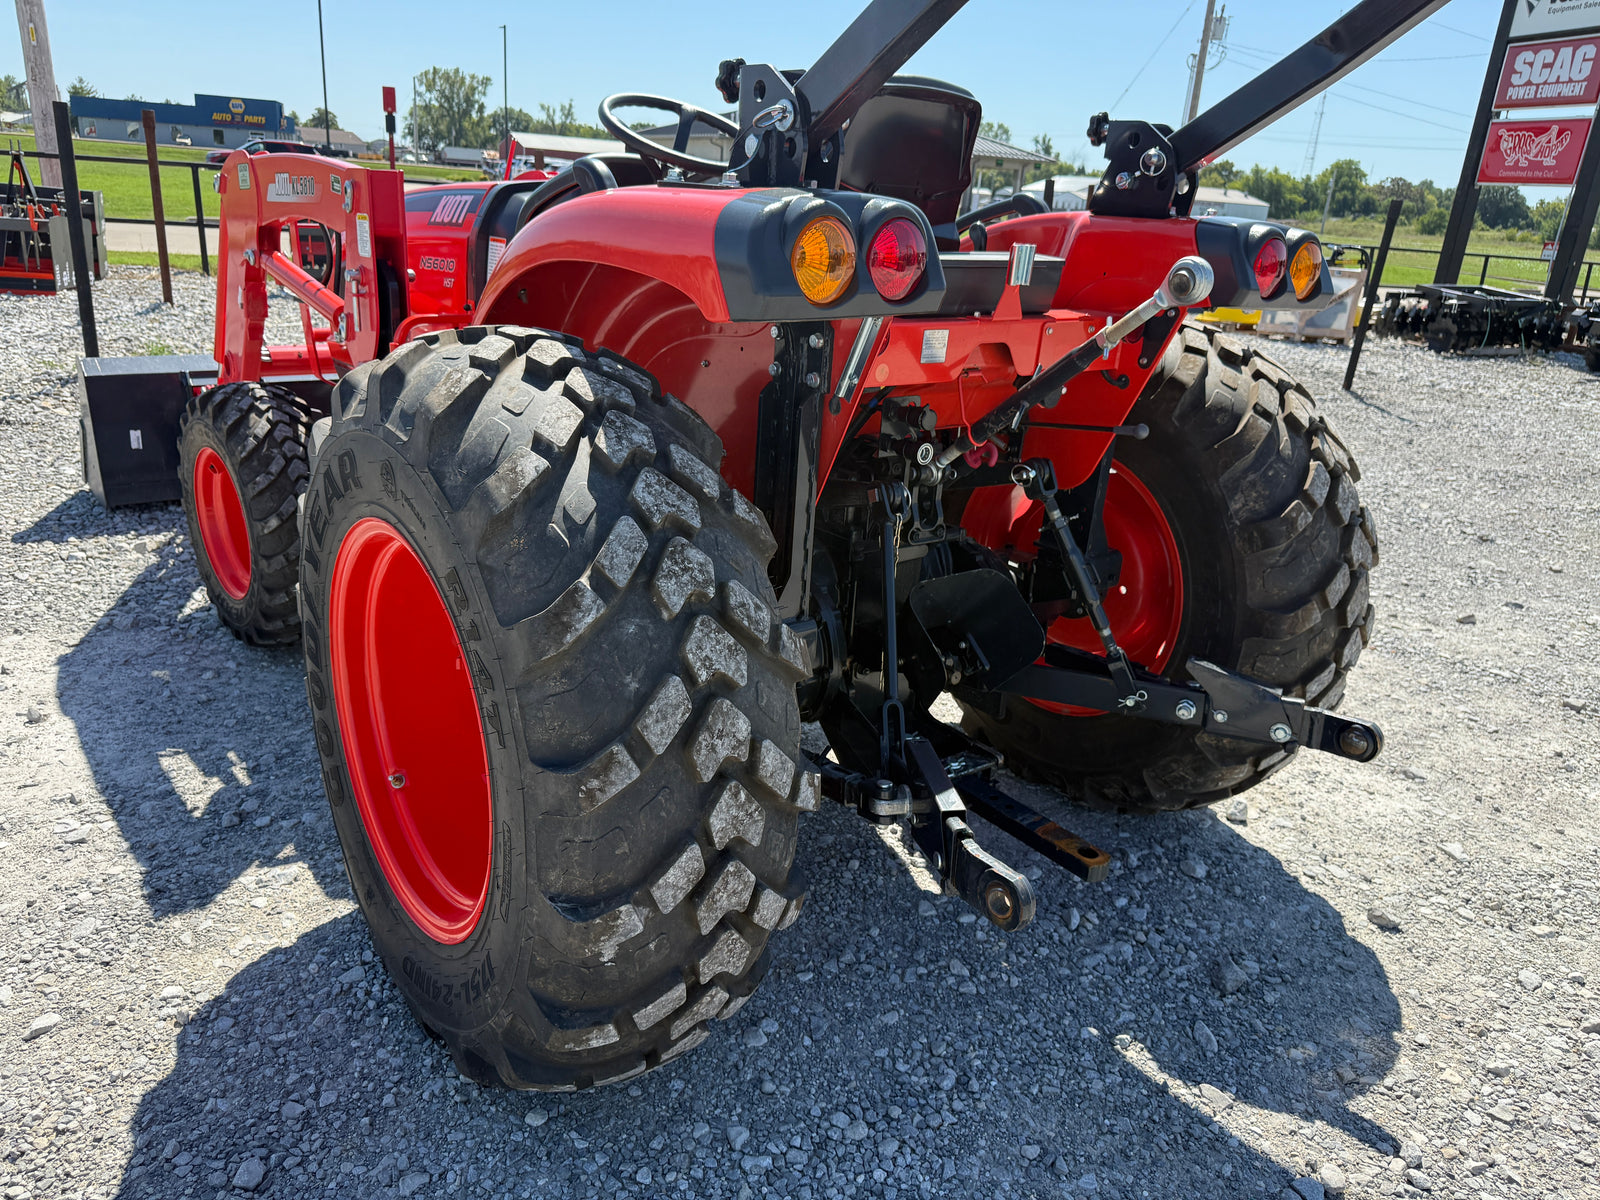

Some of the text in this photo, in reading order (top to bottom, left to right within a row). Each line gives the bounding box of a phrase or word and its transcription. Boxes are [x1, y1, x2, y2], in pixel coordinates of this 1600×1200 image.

[1547, 3, 1582, 15] Equipment
[1511, 44, 1597, 85] SCAG
[1506, 81, 1588, 100] POWER EQUIPMENT
[212, 112, 232, 121] AUTO
[244, 115, 266, 124] PARTS
[430, 195, 474, 224] KIOTI
[420, 256, 456, 272] NS6010
